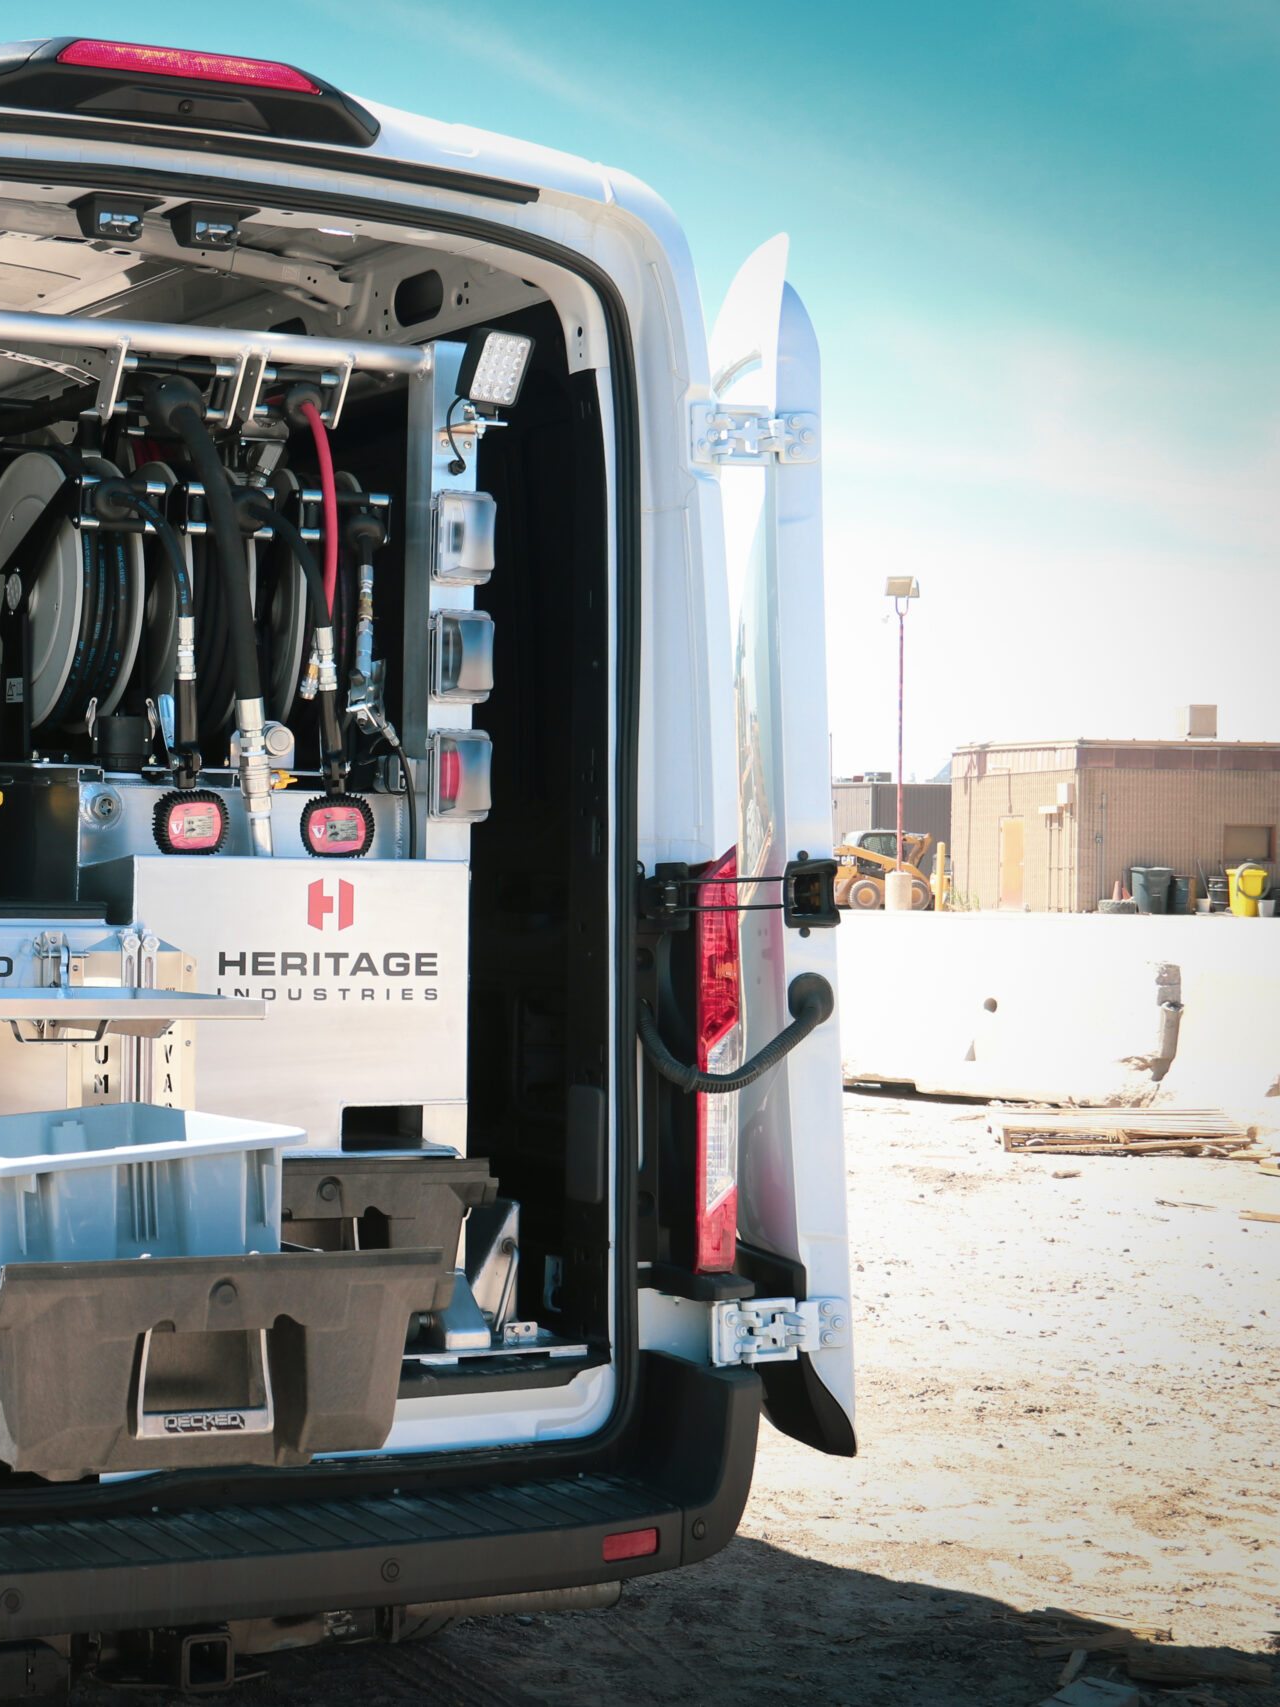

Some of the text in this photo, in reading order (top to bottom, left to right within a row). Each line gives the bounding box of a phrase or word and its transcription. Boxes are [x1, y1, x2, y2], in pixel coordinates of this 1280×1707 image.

[218, 951, 439, 977] HERITAGE
[217, 987, 439, 1001] INDUSTRIES
[164, 1413, 245, 1433] DECKED
